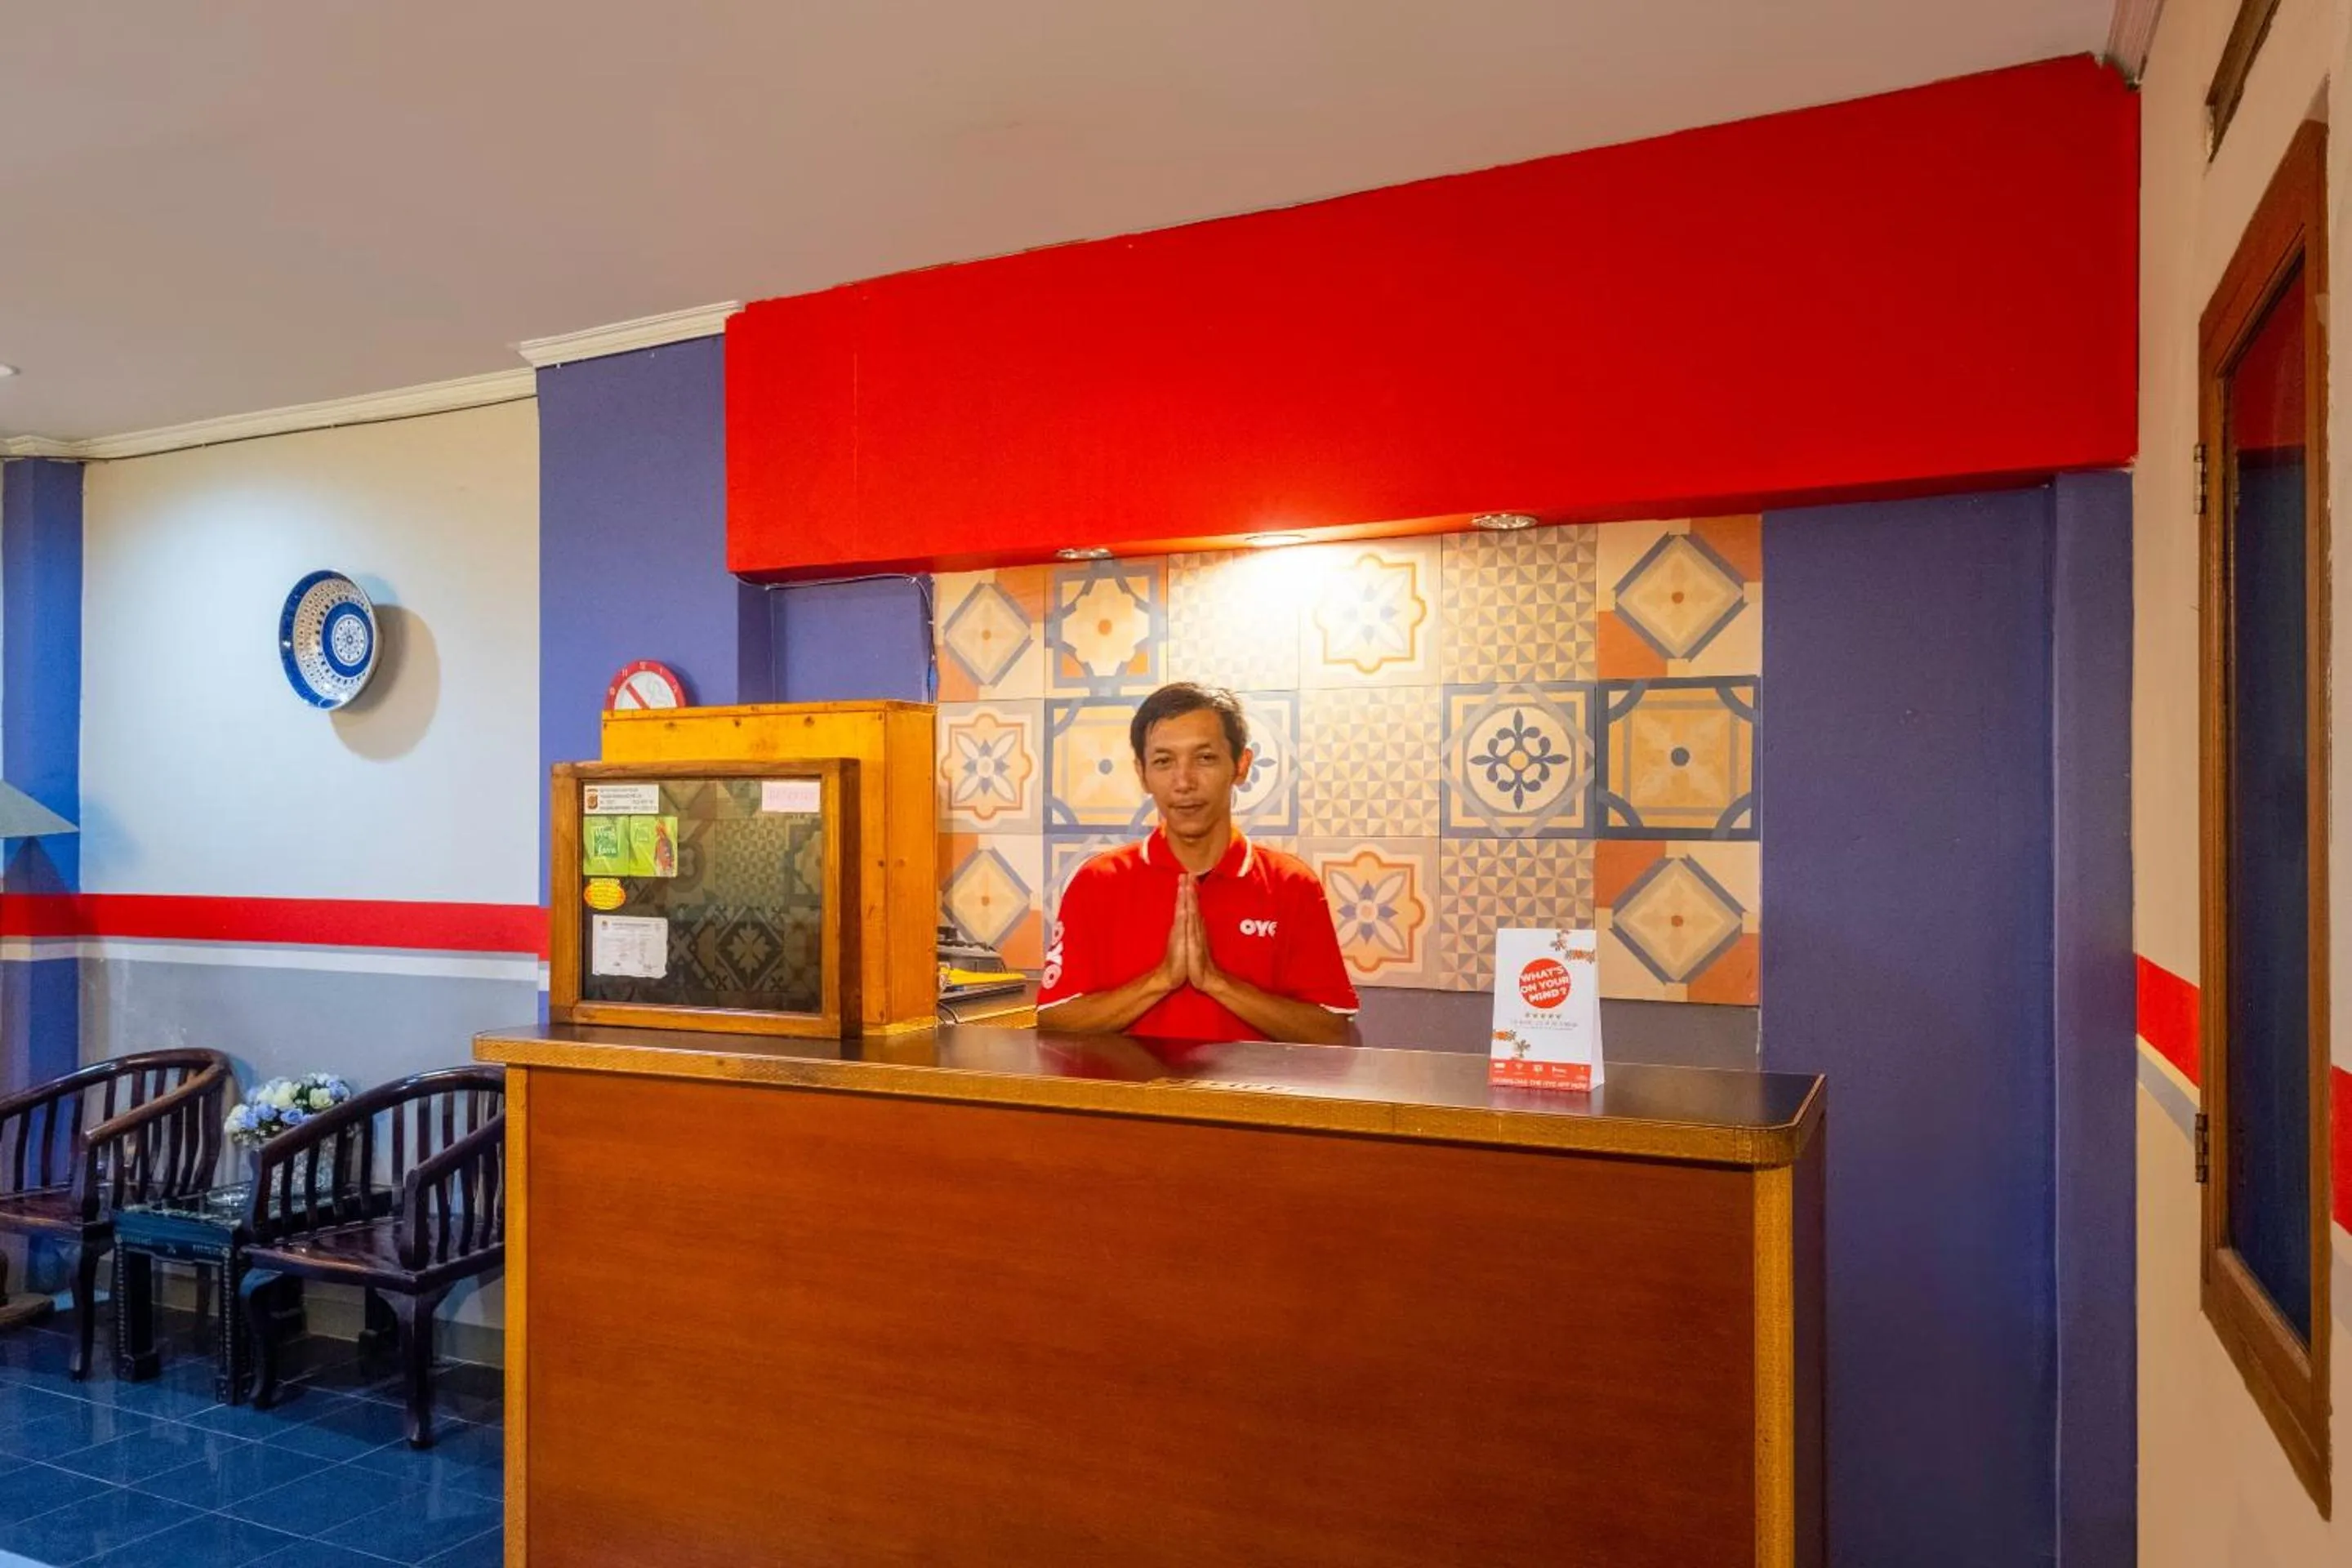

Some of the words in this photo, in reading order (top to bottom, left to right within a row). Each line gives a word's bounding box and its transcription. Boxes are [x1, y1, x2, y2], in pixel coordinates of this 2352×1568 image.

[1521, 965, 1565, 982] WHAT'S
[1521, 982, 1537, 994] ON
[1538, 976, 1570, 990] YOUR
